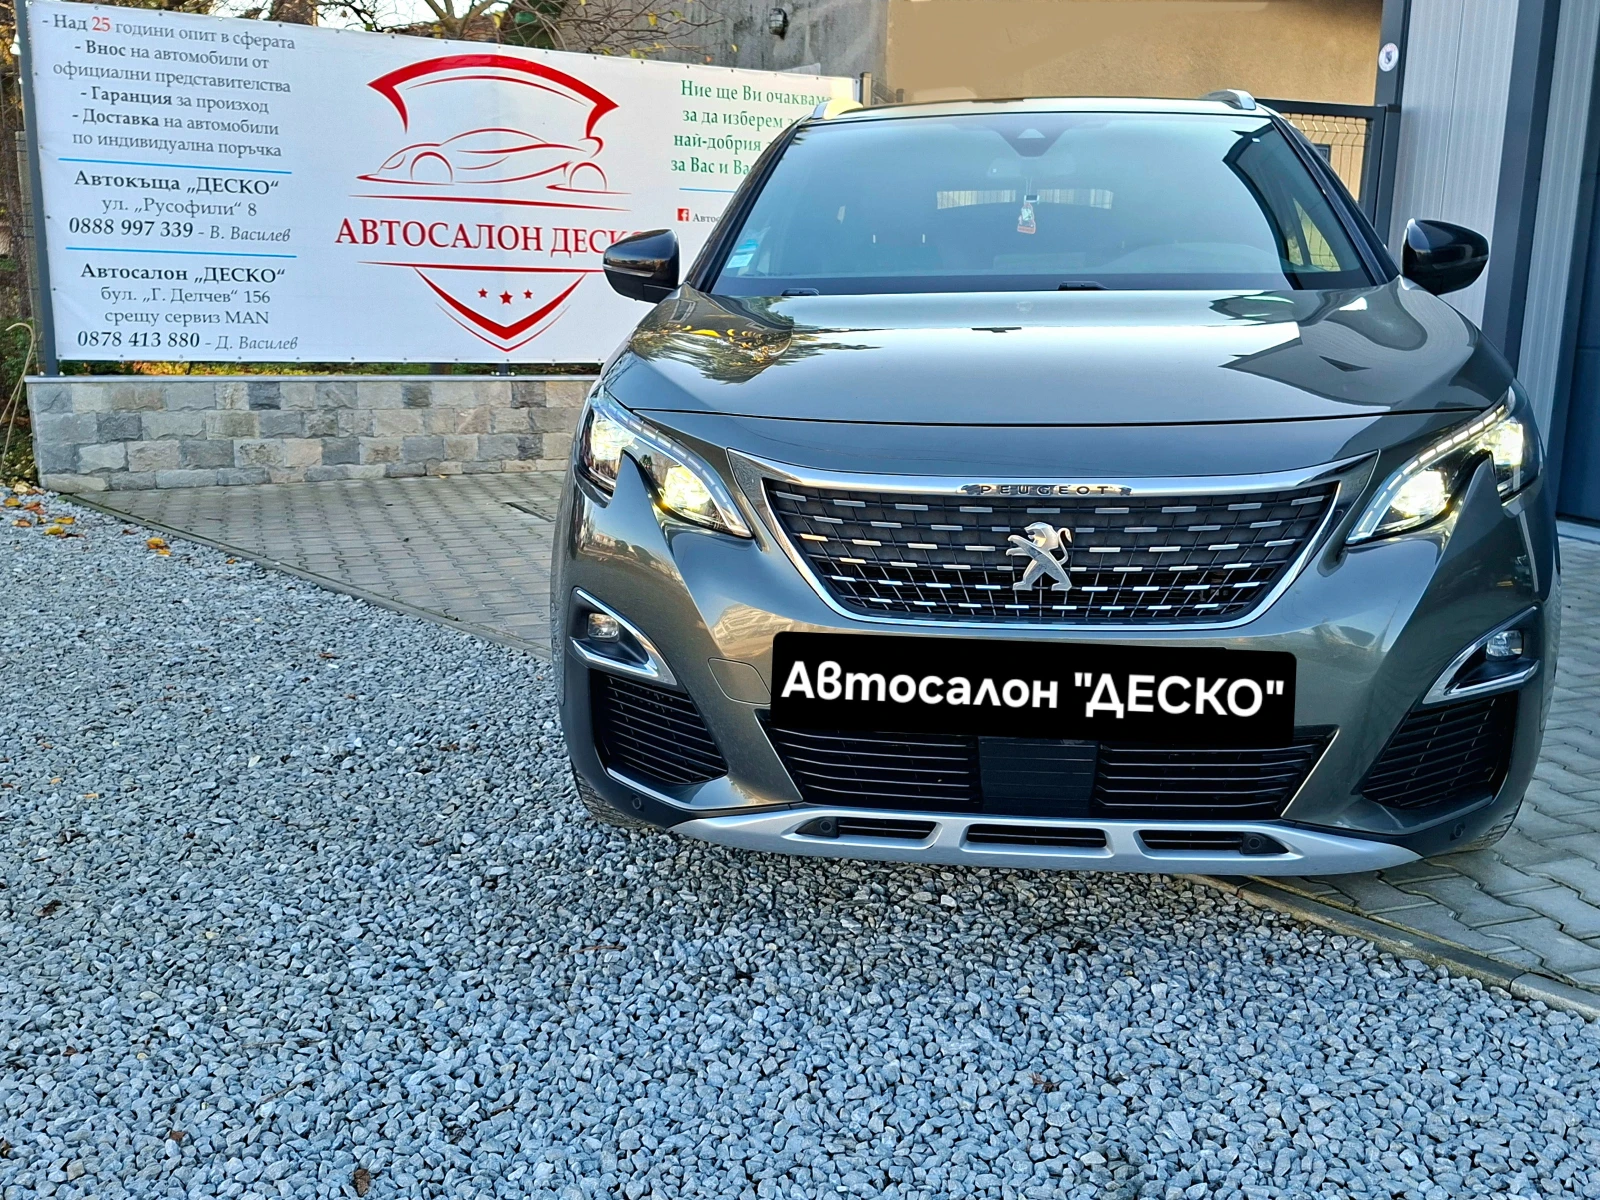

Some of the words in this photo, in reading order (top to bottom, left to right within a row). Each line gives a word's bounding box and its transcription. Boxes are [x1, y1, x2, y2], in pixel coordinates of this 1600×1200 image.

[53, 14, 87, 32] Над
[92, 17, 110, 32] 25
[115, 21, 174, 39] години
[179, 27, 217, 42] опит
[221, 32, 229, 42] в
[232, 31, 295, 50] сферата
[85, 39, 126, 56] Внос
[131, 46, 149, 58] на
[154, 48, 248, 67] автомобили
[252, 57, 269, 69] от
[53, 62, 150, 82] официални
[155, 72, 291, 93] представителства
[91, 86, 172, 108] Гаранция
[176, 96, 191, 107] за
[197, 97, 269, 114] произход
[681, 79, 712, 98] Ние
[716, 87, 738, 100] ще
[743, 85, 762, 102] Ви
[83, 108, 159, 127] Доставка
[164, 117, 182, 128] на
[187, 117, 278, 135] автомобили
[683, 109, 697, 122] за
[701, 111, 718, 124] да
[723, 110, 783, 131] изберем
[73, 133, 92, 145] по
[97, 135, 214, 155] индивидуална
[219, 144, 282, 159] поръчка
[673, 133, 761, 155] най-добрия
[671, 159, 685, 171] за
[690, 157, 714, 173] Вас
[719, 163, 728, 174] и
[74, 170, 180, 191] Автокъща
[101, 199, 128, 214] ул.
[247, 203, 257, 216] 8
[69, 217, 114, 235] 0888
[121, 220, 154, 236] 997
[160, 221, 193, 238] 339
[210, 226, 225, 240] В.
[230, 227, 291, 242] Василев
[335, 217, 543, 252] АВТОСАЛОН
[551, 228, 645, 258] ДЕСК
[80, 263, 188, 281] Автосалон
[101, 287, 137, 304] бул.
[243, 290, 271, 304] 156
[104, 311, 160, 326] срещу
[165, 313, 220, 327] сервиз
[225, 311, 269, 324] MAN
[77, 331, 122, 347] 0878
[128, 331, 161, 348] 413
[168, 332, 200, 348] 880
[215, 336, 233, 350] Д.
[239, 336, 299, 350] Василев
[980, 485, 1109, 495] PEUGEOT
